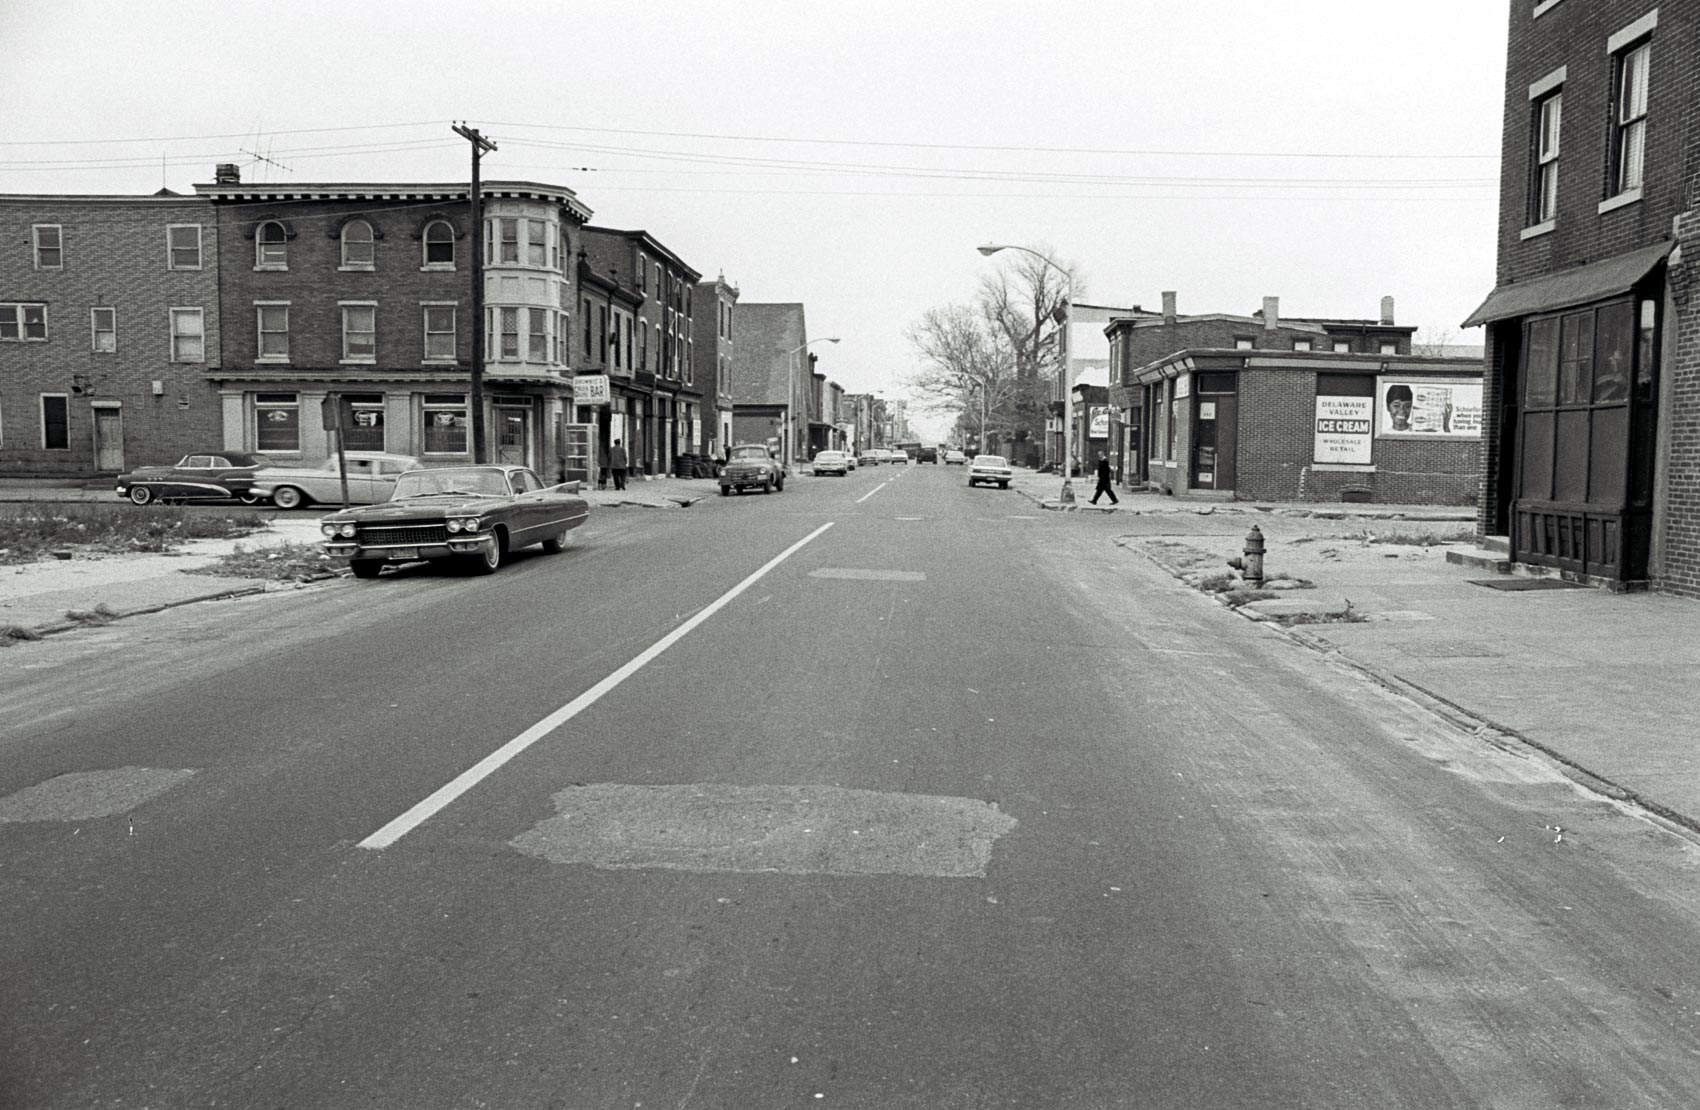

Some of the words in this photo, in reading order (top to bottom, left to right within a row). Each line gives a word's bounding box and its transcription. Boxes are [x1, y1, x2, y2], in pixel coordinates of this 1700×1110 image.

[590, 385, 604, 398] BAR
[1322, 401, 1366, 409] DELAWARE
[1318, 420, 1335, 432] ICE
[1336, 420, 1369, 433] CREAM
